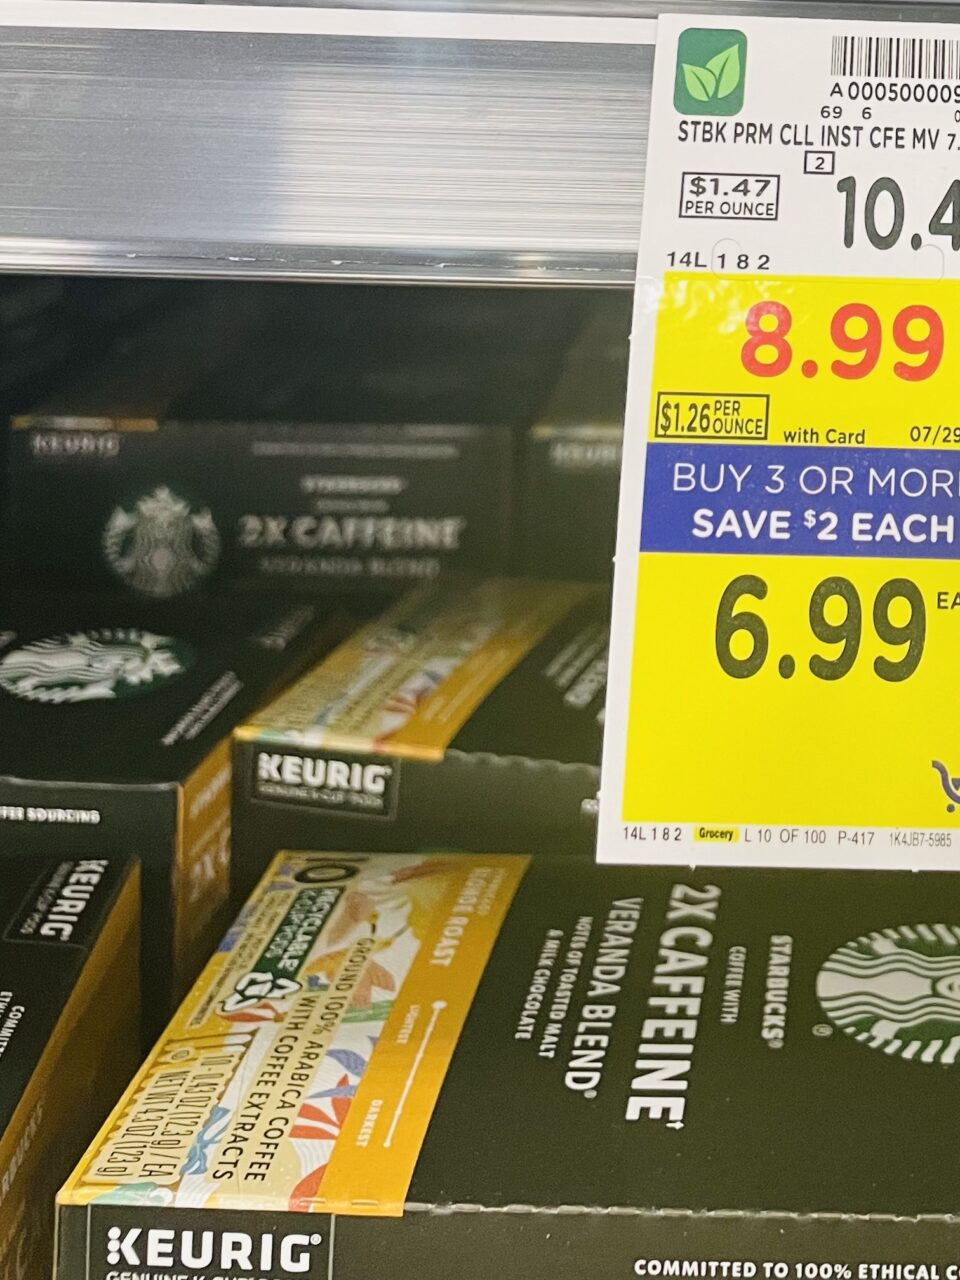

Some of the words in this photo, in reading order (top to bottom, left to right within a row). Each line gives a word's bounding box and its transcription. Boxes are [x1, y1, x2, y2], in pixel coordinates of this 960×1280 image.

[820, 106, 843, 120] 69
[861, 106, 872, 120] 6
[678, 120, 727, 143] STBK
[733, 122, 773, 145] PRM
[779, 124, 814, 146] CLL
[820, 125, 864, 147] INST
[869, 127, 906, 149] CFE
[912, 128, 940, 150] MV
[689, 176, 771, 198] $1.47
[684, 200, 715, 215] PER
[719, 201, 775, 217] OUNCE
[666, 252, 707, 268] 14L
[741, 300, 945, 382] 8.99
[660, 400, 711, 437] $1.26
[713, 400, 741, 417] PER
[712, 418, 763, 436] OUNCE
[783, 428, 820, 444] with
[825, 430, 866, 445] Card
[672, 462, 752, 493] BUY
[765, 465, 785, 494] 3
[799, 466, 853, 495] OR
[692, 509, 791, 540] SAVE
[803, 509, 838, 541] $2
[852, 513, 954, 544] EACH
[715, 573, 927, 683] 6.99
[623, 827, 646, 840] 14L
[699, 827, 734, 841] Grocery
[758, 829, 772, 843] 10
[779, 829, 799, 843] OF
[804, 830, 827, 844] 100
[837, 831, 875, 846] P-417
[889, 832, 952, 848] 1K4JB7-5985
[295, 856, 369, 883] 10
[666, 883, 722, 922] 2X
[570, 916, 593, 948] NOTES
[587, 897, 644, 997] VERANDA
[336, 937, 375, 993] GROUND
[514, 968, 551, 1040] CHOCOLATE
[550, 967, 579, 1020] TOASTED
[285, 995, 320, 1033] WITH
[538, 1023, 562, 1058] MALT
[200, 1053, 235, 1066] 10
[256, 1034, 298, 1088] COFFEE
[276, 1039, 324, 1111] ARABICA
[184, 1072, 224, 1095] 0.43
[212, 1092, 271, 1181] EXTRACTS
[356, 1099, 383, 1148] DARKEST
[244, 1118, 290, 1182] COFFEE
[634, 1258, 756, 1278] COMMITTED
[763, 1261, 789, 1279] TO
[795, 1262, 852, 1279] 100%
[857, 1263, 939, 1280] ETHICAL
